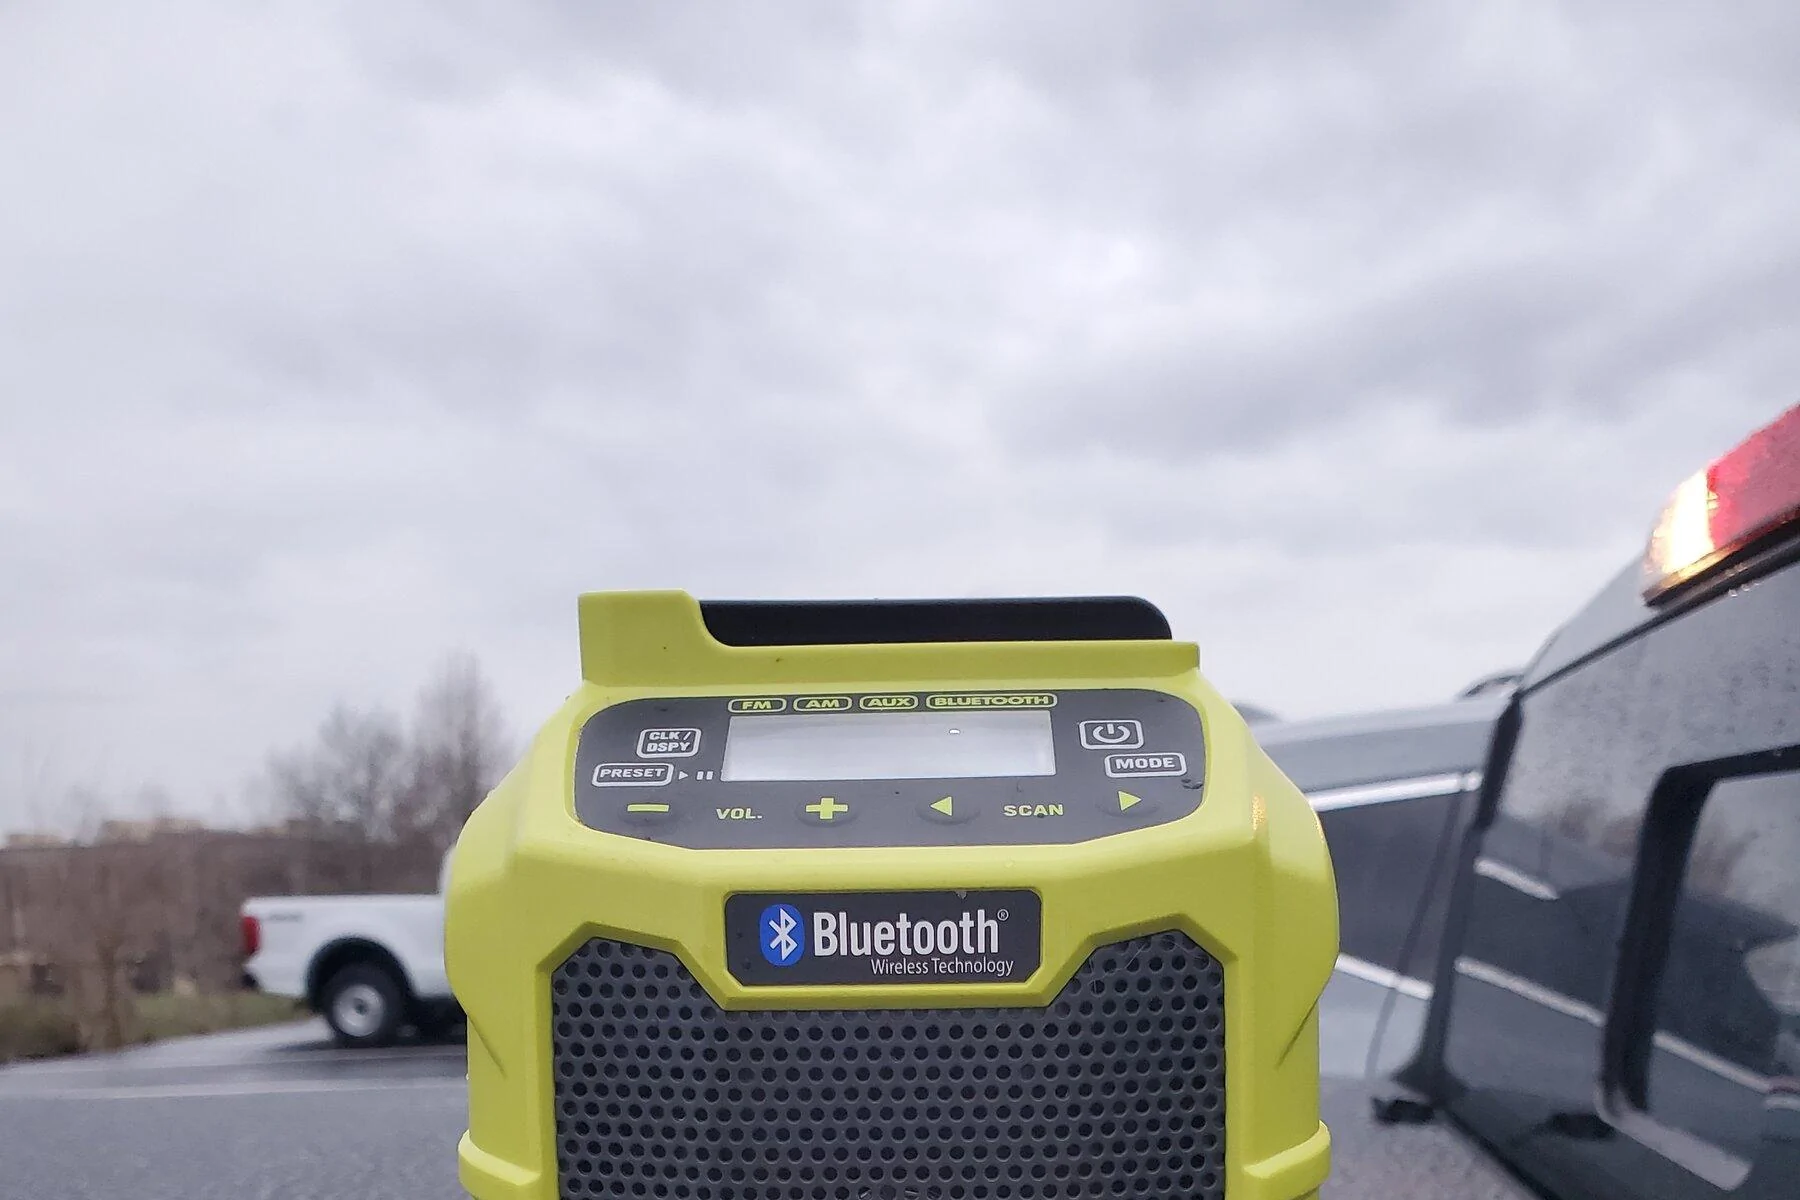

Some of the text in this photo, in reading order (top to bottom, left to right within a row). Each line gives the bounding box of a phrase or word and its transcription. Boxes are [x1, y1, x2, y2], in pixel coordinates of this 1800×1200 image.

[742, 700, 772, 710] FM
[805, 698, 840, 709] AM
[868, 697, 912, 708] AUX
[934, 695, 1050, 706] BLUETOOTH
[646, 741, 691, 752] DSPY
[1115, 756, 1176, 770] MODE
[600, 767, 666, 778] PRESET
[716, 807, 763, 820] VOL.
[1003, 803, 1065, 817] SCAN
[870, 957, 1014, 977] Wireless Technology
